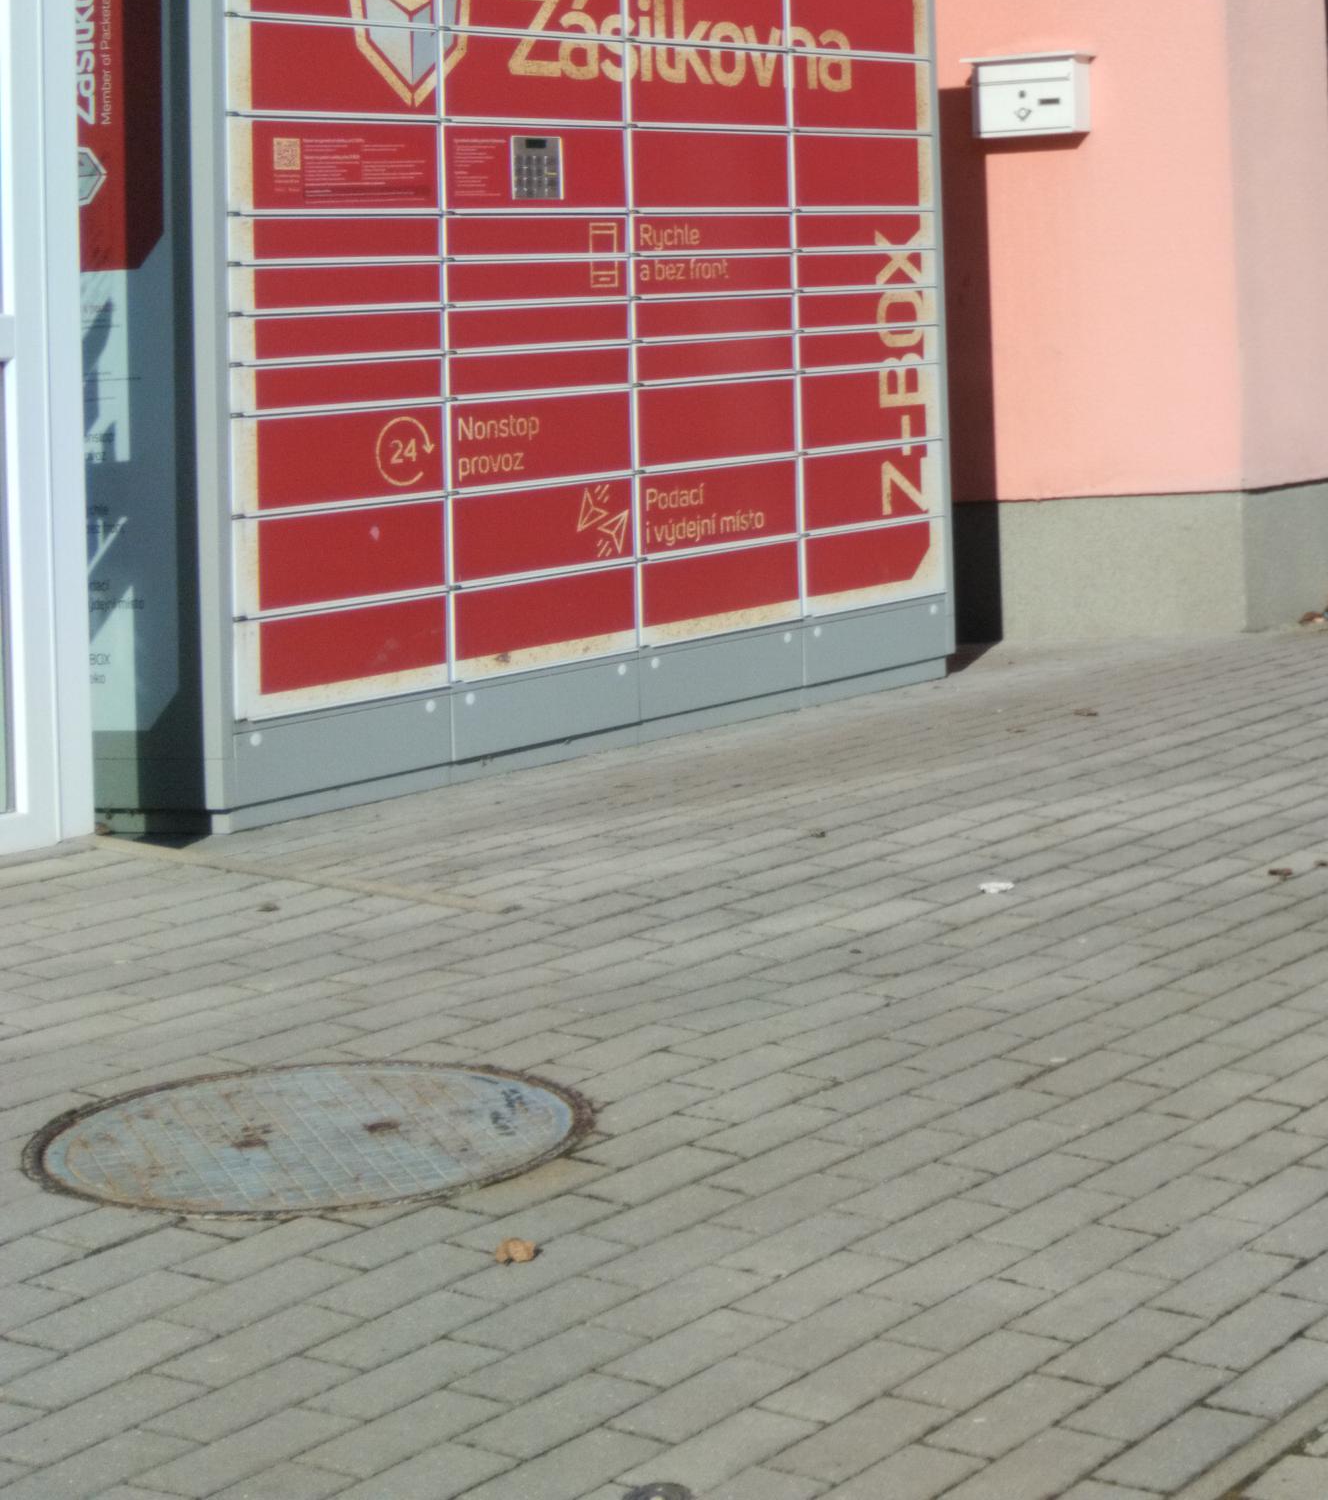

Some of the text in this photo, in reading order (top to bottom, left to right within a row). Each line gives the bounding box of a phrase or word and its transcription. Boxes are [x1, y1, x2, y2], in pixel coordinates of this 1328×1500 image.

[101, 53, 111, 66] of
[100, 71, 112, 125] Member
[640, 223, 700, 250] Rychle
[640, 258, 729, 281] a bez front
[874, 228, 929, 516] Z-BOX
[457, 414, 540, 441] Nonstop
[389, 437, 418, 465] 24
[458, 452, 525, 483] provoz
[645, 482, 705, 512] Podací
[645, 509, 765, 547] i výdejní místo
